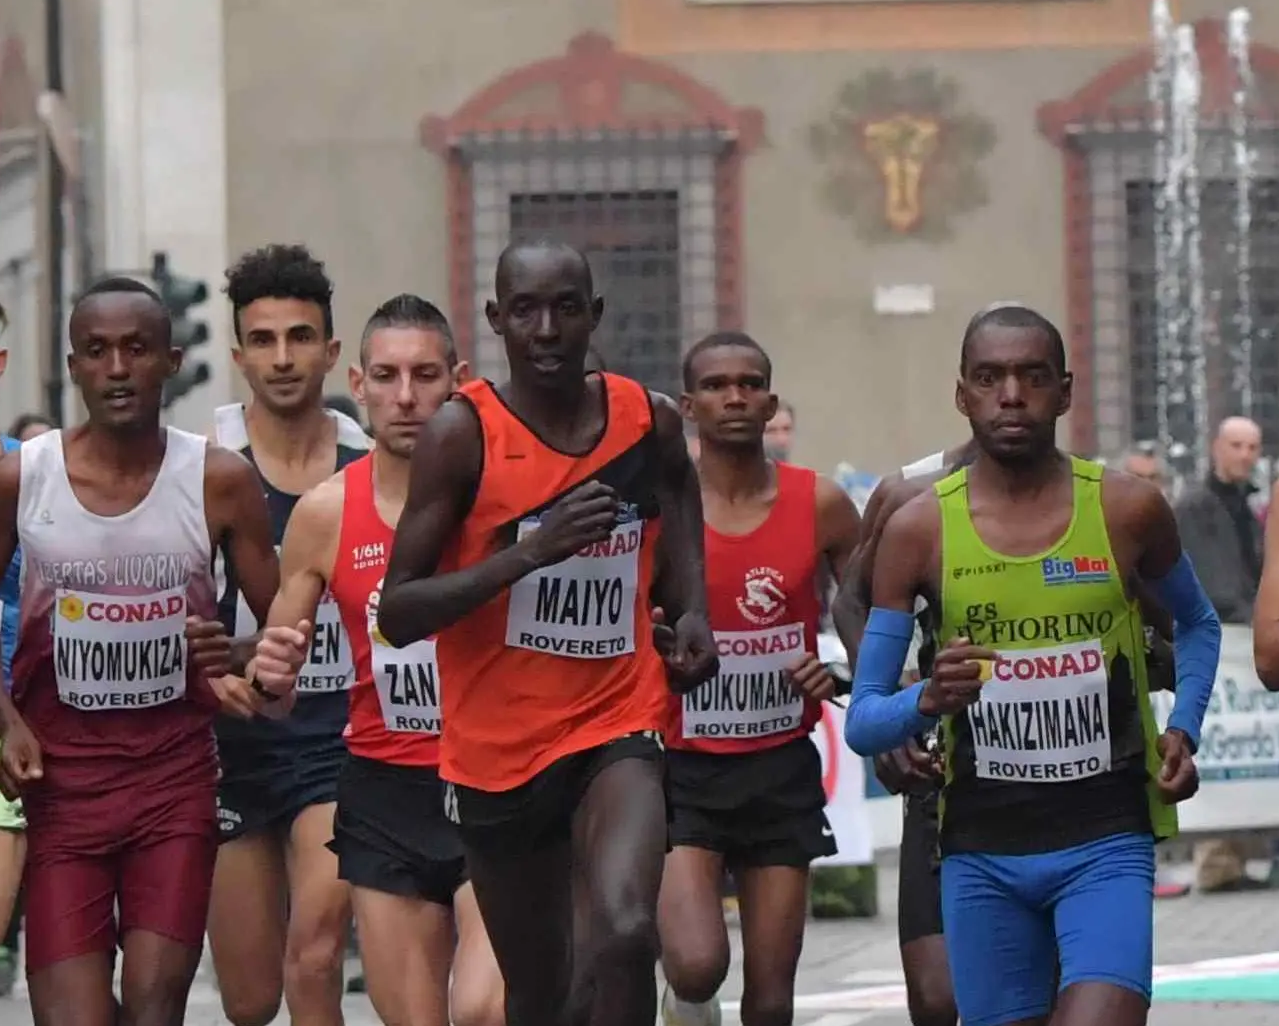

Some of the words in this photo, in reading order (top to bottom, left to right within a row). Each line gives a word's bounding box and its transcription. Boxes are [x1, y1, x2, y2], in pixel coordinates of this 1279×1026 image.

[352, 542, 385, 559] 1/6H
[353, 559, 385, 570] sport
[1043, 556, 1109, 578] BigMat
[87, 596, 184, 623] CONAD
[535, 576, 623, 627] MAIYO
[966, 602, 998, 632] gs
[990, 610, 1114, 643] FIORINO
[520, 632, 626, 655] ROVERETO
[716, 631, 802, 657] CONAD
[56, 634, 183, 682] NIYOMUKIZA
[994, 649, 1102, 682] CONAD
[297, 675, 347, 690] RETO
[69, 686, 175, 708] ROVERETO
[694, 715, 793, 737] ROVERETO
[971, 693, 1106, 751] HAKIZIMANA
[988, 756, 1101, 779] ROVERETO
